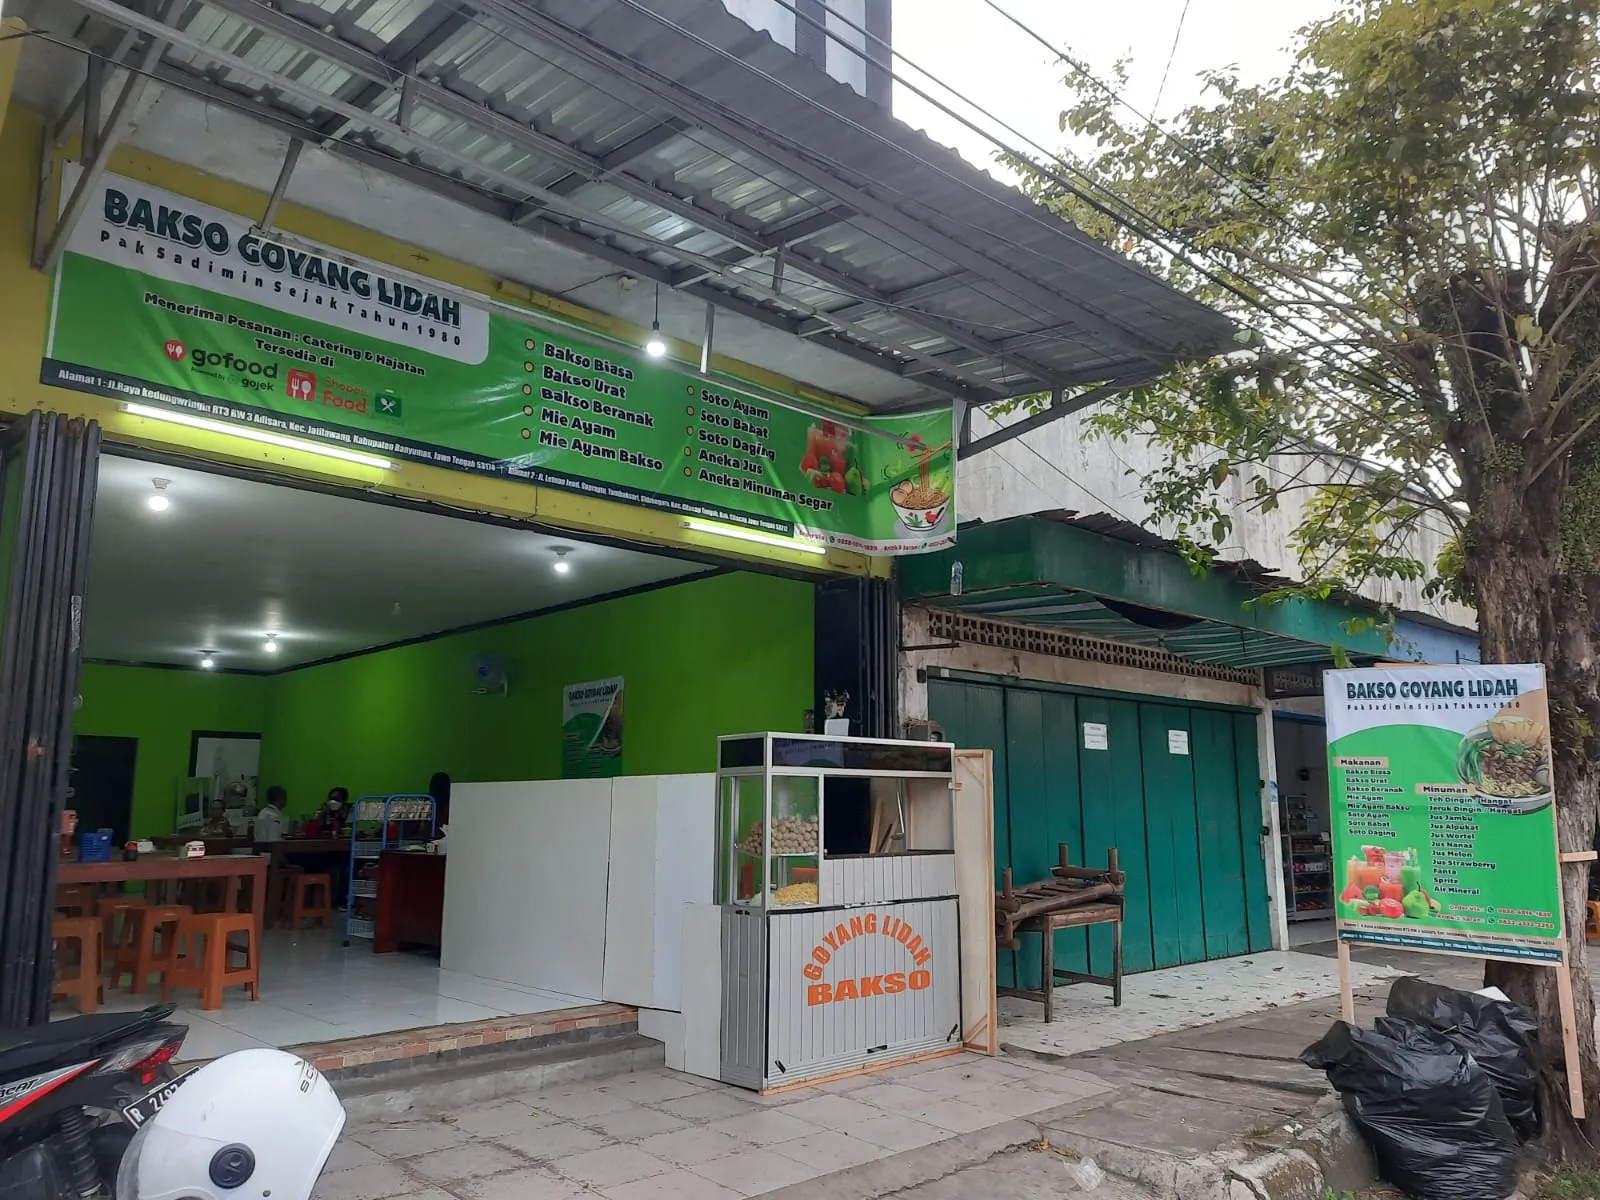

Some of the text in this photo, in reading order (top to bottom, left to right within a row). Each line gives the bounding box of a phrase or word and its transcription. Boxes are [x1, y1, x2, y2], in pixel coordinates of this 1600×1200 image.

[104, 188, 460, 326] BAKSO GOYANG LIDAH
[144, 292, 224, 322] Menerima
[228, 314, 292, 340] Pesanan
[302, 334, 362, 360] Catering
[364, 350, 374, 361] &
[376, 354, 425, 377] Hajatan
[191, 348, 279, 378] gofood
[255, 338, 334, 368] Tersedia di
[544, 342, 634, 382] Bakso Biasa
[241, 378, 274, 392] gojek
[542, 365, 626, 400] Bakso Urat
[323, 390, 367, 414] Food
[541, 387, 655, 428] Bakso Beranak
[700, 388, 769, 421] Soto Ayam
[58, 368, 95, 386] Alamat
[212, 405, 230, 417] RT3
[230, 408, 246, 420] RW
[246, 412, 252, 422] 3
[289, 422, 307, 434] Kec.
[353, 434, 394, 451] Kabupaten
[434, 451, 451, 462] Jawa
[452, 455, 476, 468] Tengah
[541, 408, 617, 440] Mie Ayam
[700, 409, 769, 440] Soto Babat
[539, 430, 664, 472] Mie Ayam Bakso
[698, 428, 776, 463] Soto Daging
[698, 449, 764, 476] Aneka Jus
[698, 468, 833, 512] Aneka Minuman Segar
[1346, 678, 1518, 699] BAKSO GOYANG LIDAH
[1340, 758, 1382, 766] Makanan
[1362, 794, 1384, 802] Ayam
[1423, 786, 1468, 794] Minuman
[1445, 796, 1473, 804] Dingin
[1445, 814, 1473, 822] Jambu
[1454, 806, 1482, 814] Dingin
[1368, 829, 1396, 838] Daging
[1433, 868, 1457, 876] Fanta
[1448, 860, 1496, 870] Strawberry
[1448, 887, 1480, 895] Mineral
[803, 912, 932, 982] GOYANG LIDAH
[808, 969, 931, 1006] BAKSO
[129, 1107, 145, 1123] R
